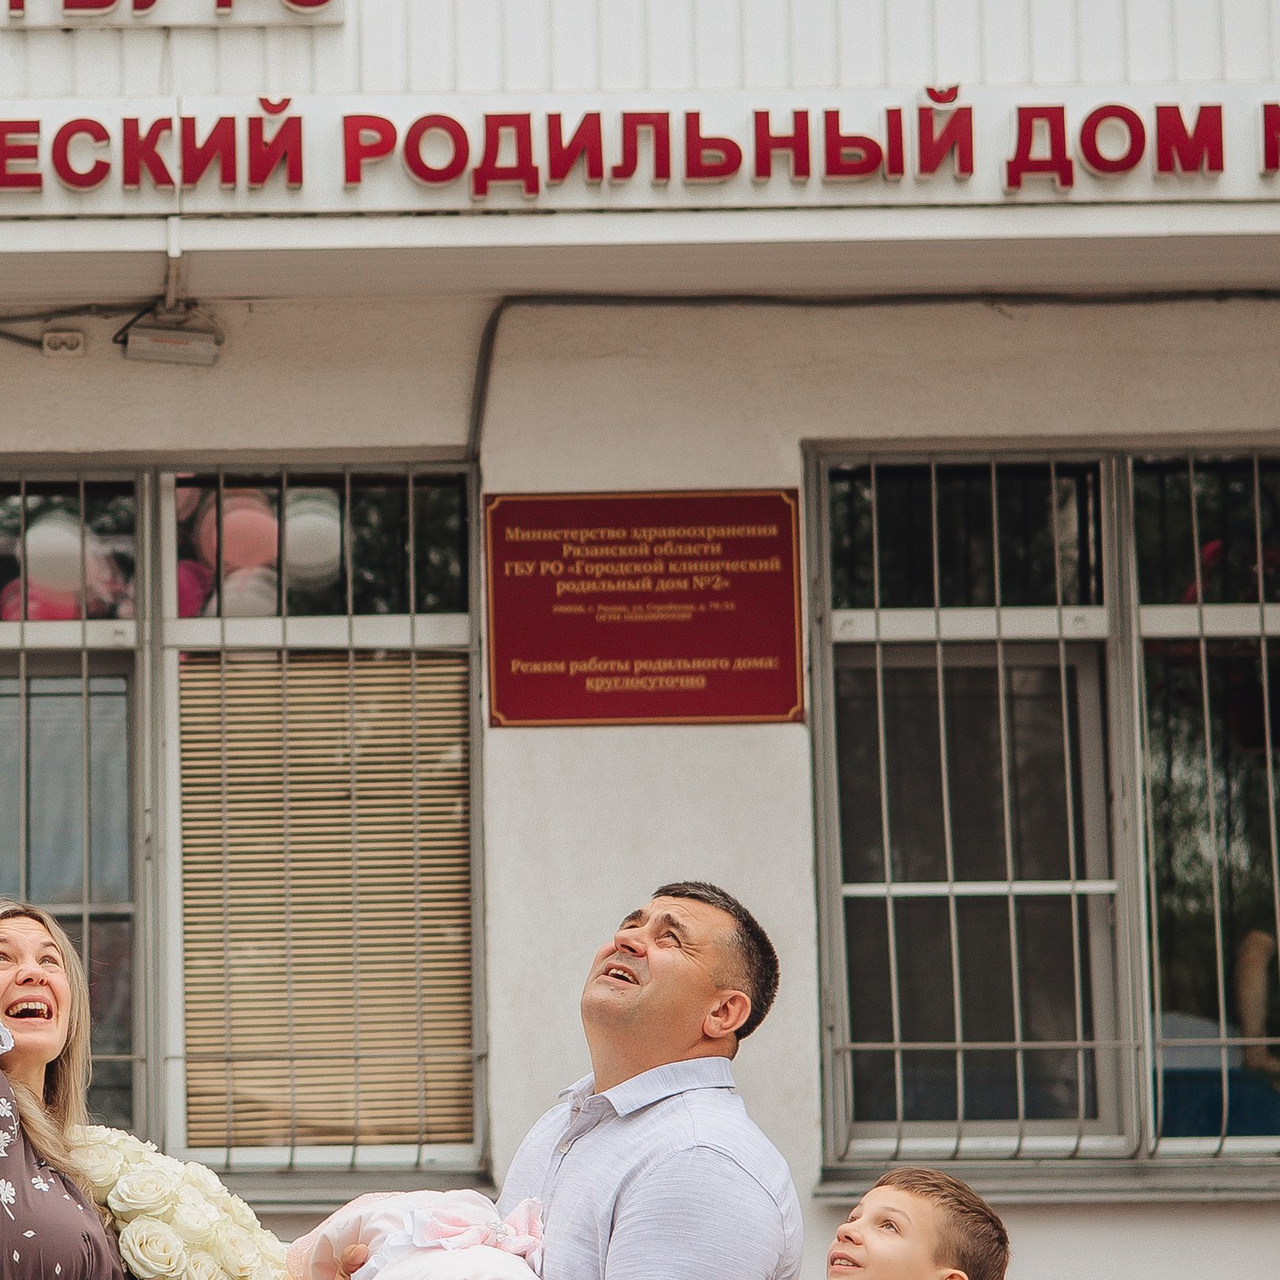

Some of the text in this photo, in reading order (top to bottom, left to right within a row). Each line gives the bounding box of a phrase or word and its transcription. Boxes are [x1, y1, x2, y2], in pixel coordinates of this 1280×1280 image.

[343, 84, 974, 200] РОДИЛЬНЫЙ
[1004, 103, 1224, 191] ДОМ
[505, 523, 778, 542] Министерство здравоохранения
[563, 541, 722, 558] Рязанской области
[505, 560, 534, 576] ГБУ
[540, 560, 564, 576] РО
[669, 556, 781, 573] клинический
[556, 577, 652, 595] родильный
[655, 579, 688, 592] дом
[511, 658, 566, 673] Режим
[569, 657, 630, 675] работы
[634, 657, 730, 674] родильного
